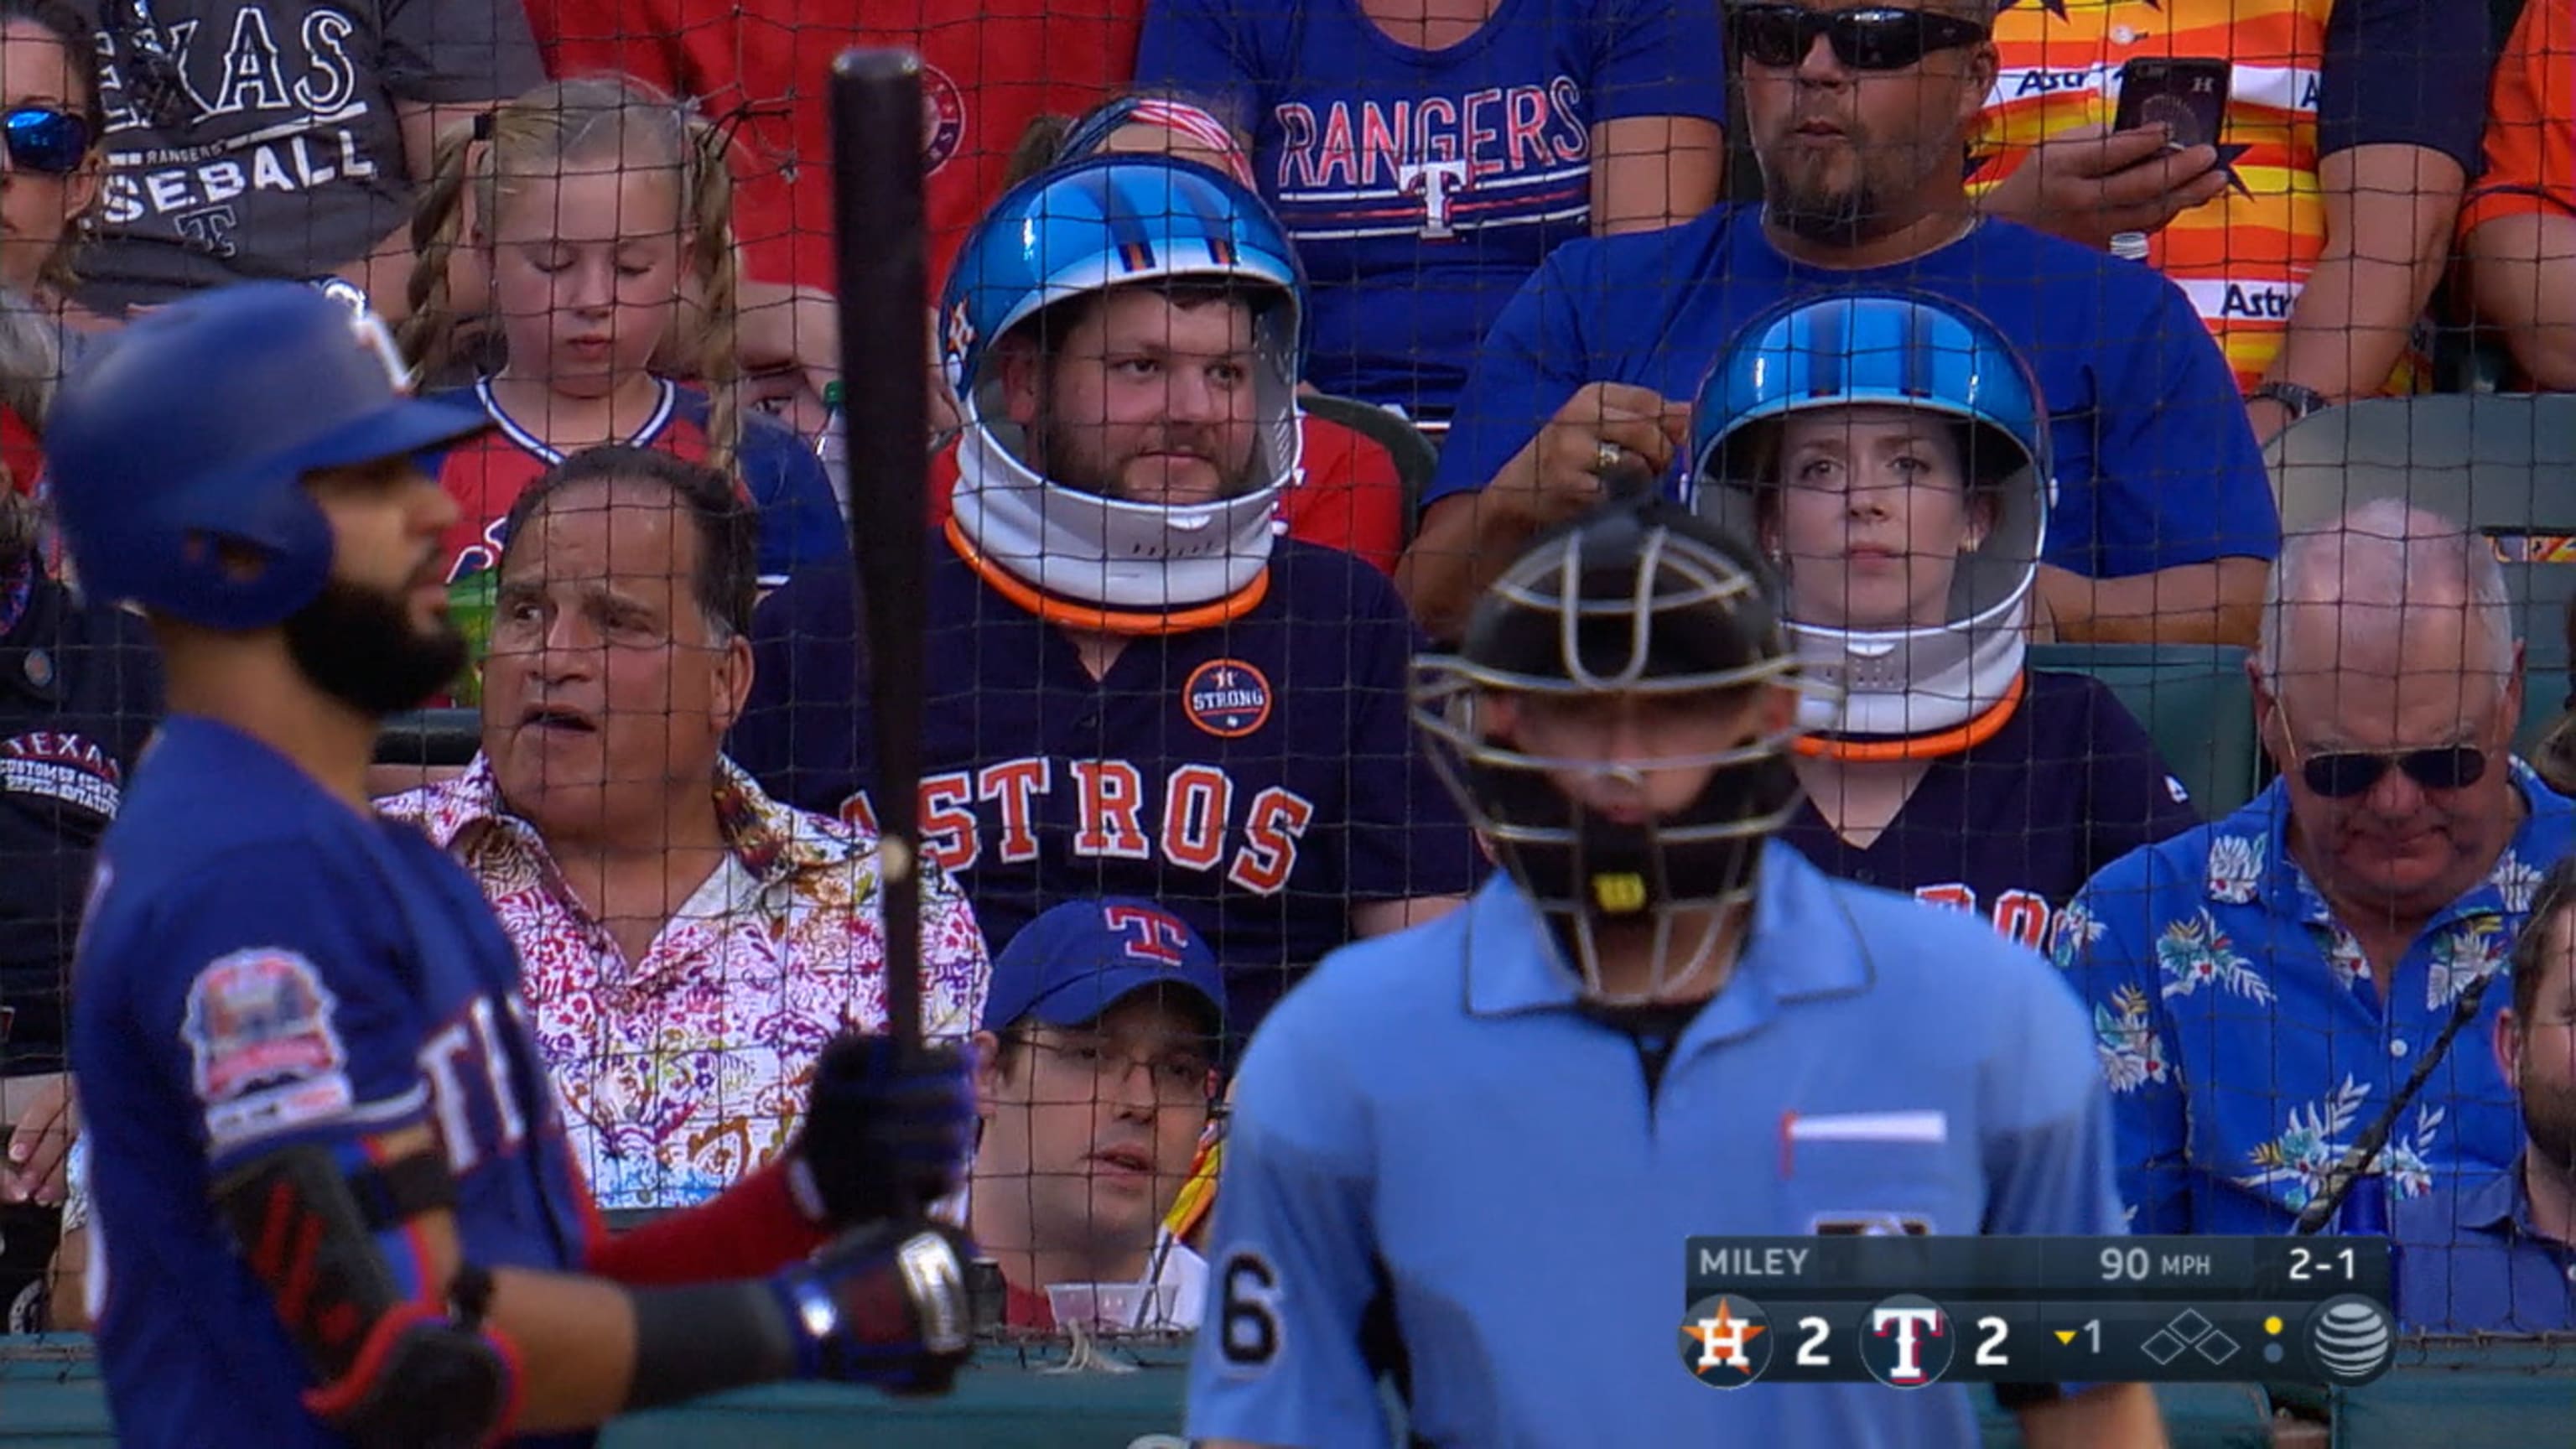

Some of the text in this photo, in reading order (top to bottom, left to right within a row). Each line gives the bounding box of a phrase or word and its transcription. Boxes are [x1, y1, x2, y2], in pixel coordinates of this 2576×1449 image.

[146, 141, 226, 164] RANGERS
[1275, 75, 1590, 188] RANGERS
[80, 129, 374, 231] SEBALL
[1399, 159, 1467, 245] T
[2220, 283, 2298, 317] Astr
[1192, 687, 1265, 712] STRONG
[1104, 906, 1188, 967] T
[1219, 1251, 1281, 1368] 6
